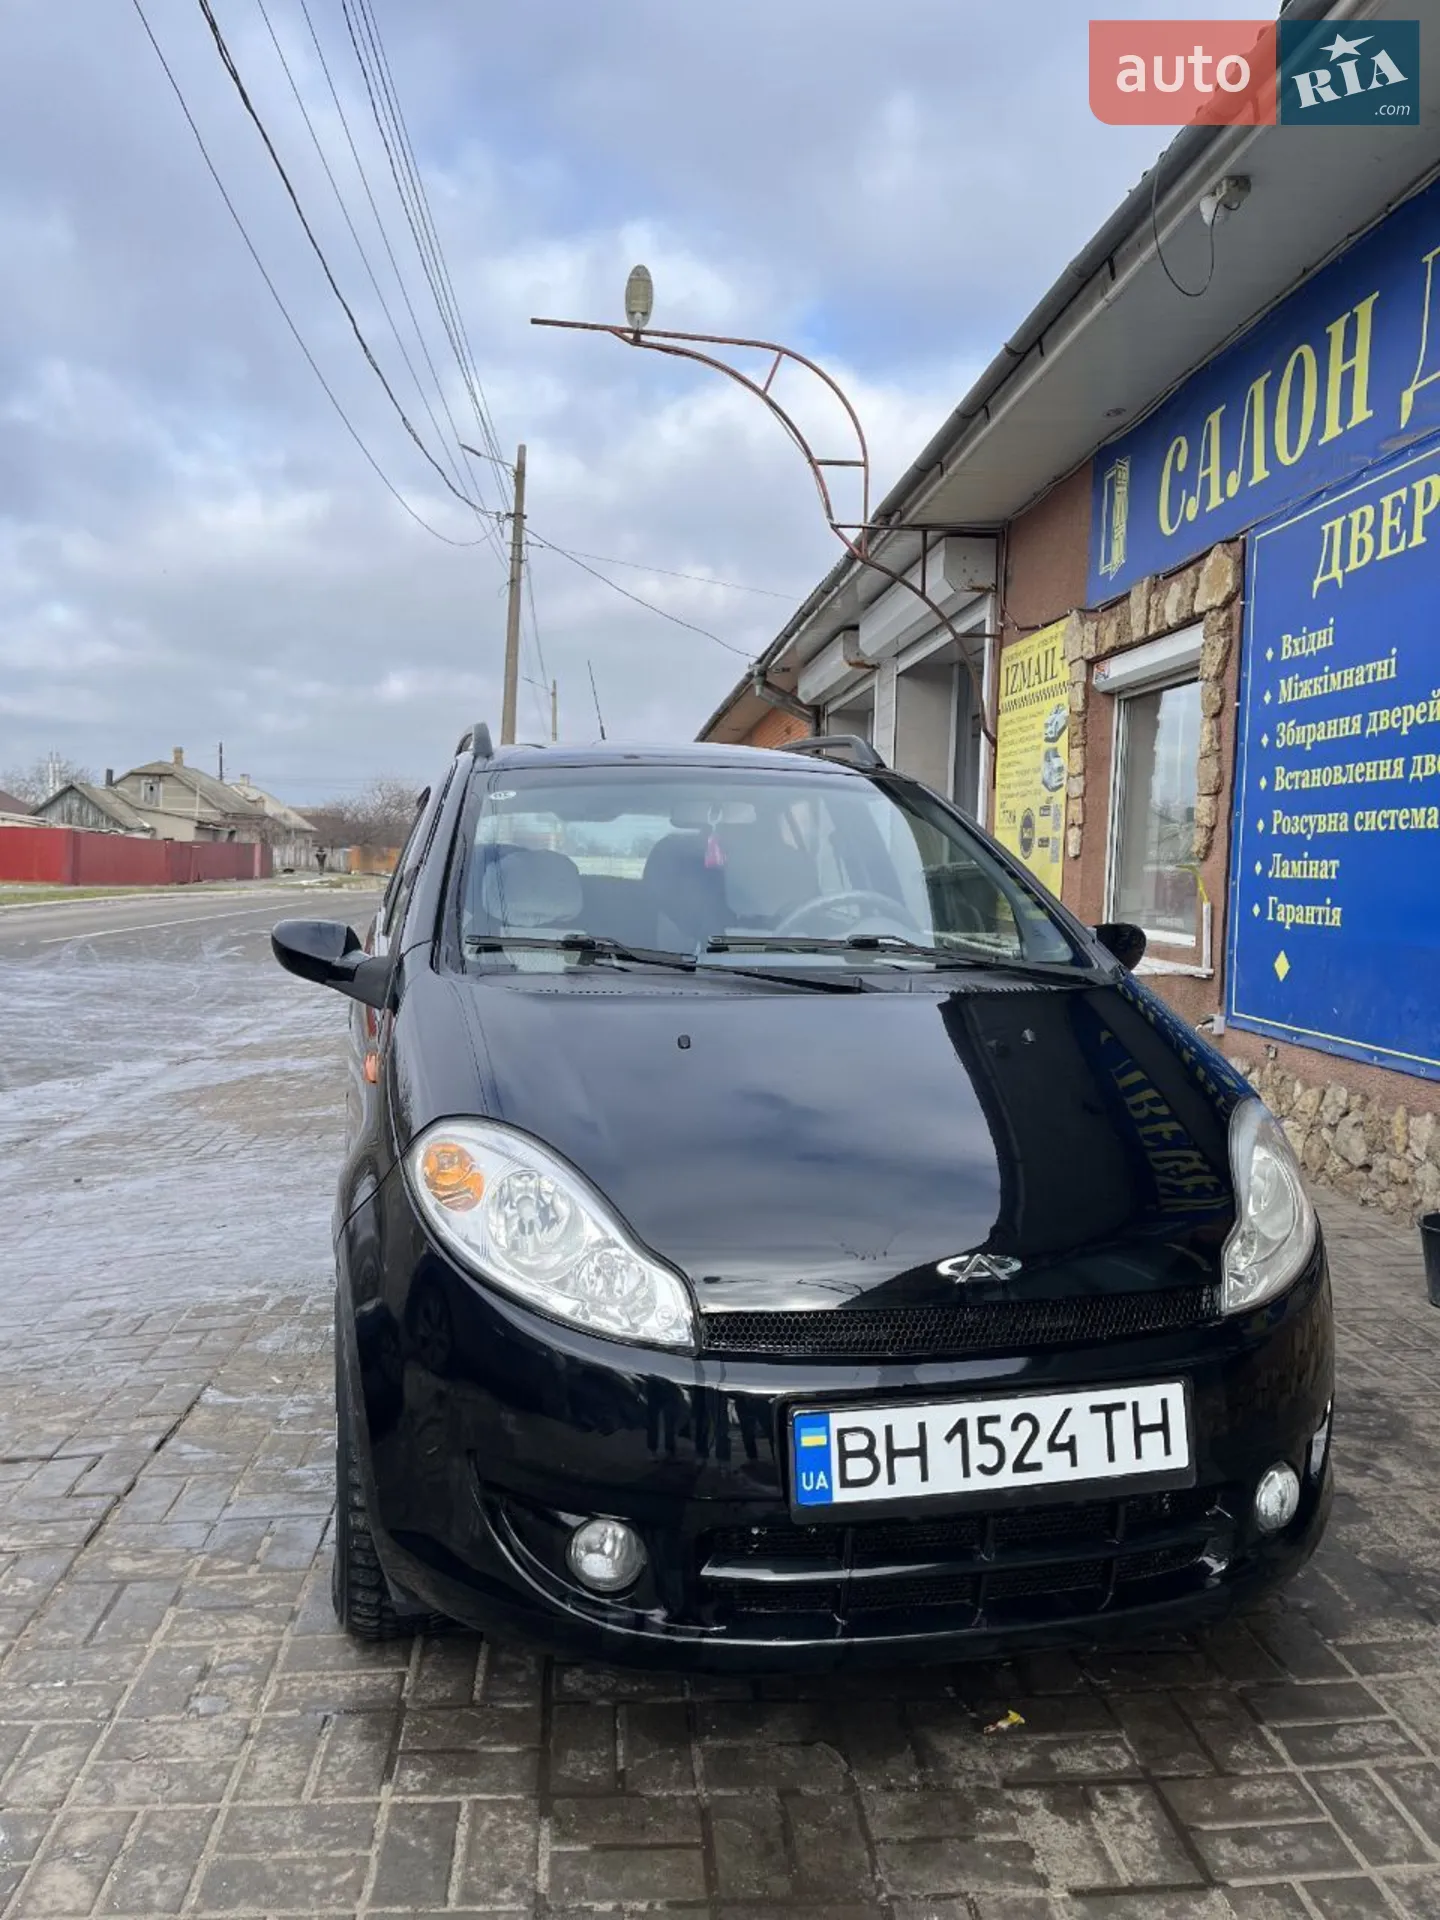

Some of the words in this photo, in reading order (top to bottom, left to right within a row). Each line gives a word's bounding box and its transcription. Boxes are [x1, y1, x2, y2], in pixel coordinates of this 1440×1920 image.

[1158, 290, 1380, 537] САЛОН
[1280, 617, 1335, 661] Вхідні
[1004, 646, 1058, 696] IZMAIL
[1277, 647, 1397, 704] Міжкімнатні
[1276, 713, 1362, 750] Збирання
[1366, 688, 1440, 738] дверей
[1274, 757, 1404, 791] Встановлення
[1271, 809, 1349, 840] Розсувна
[1354, 806, 1439, 832] система
[1268, 851, 1340, 879] Ламінат
[1267, 896, 1342, 929] Гарантія
[837, 1421, 929, 1488] BH
[943, 1407, 1079, 1478] 1524
[1089, 1397, 1172, 1463] TH
[802, 1470, 829, 1491] UA
